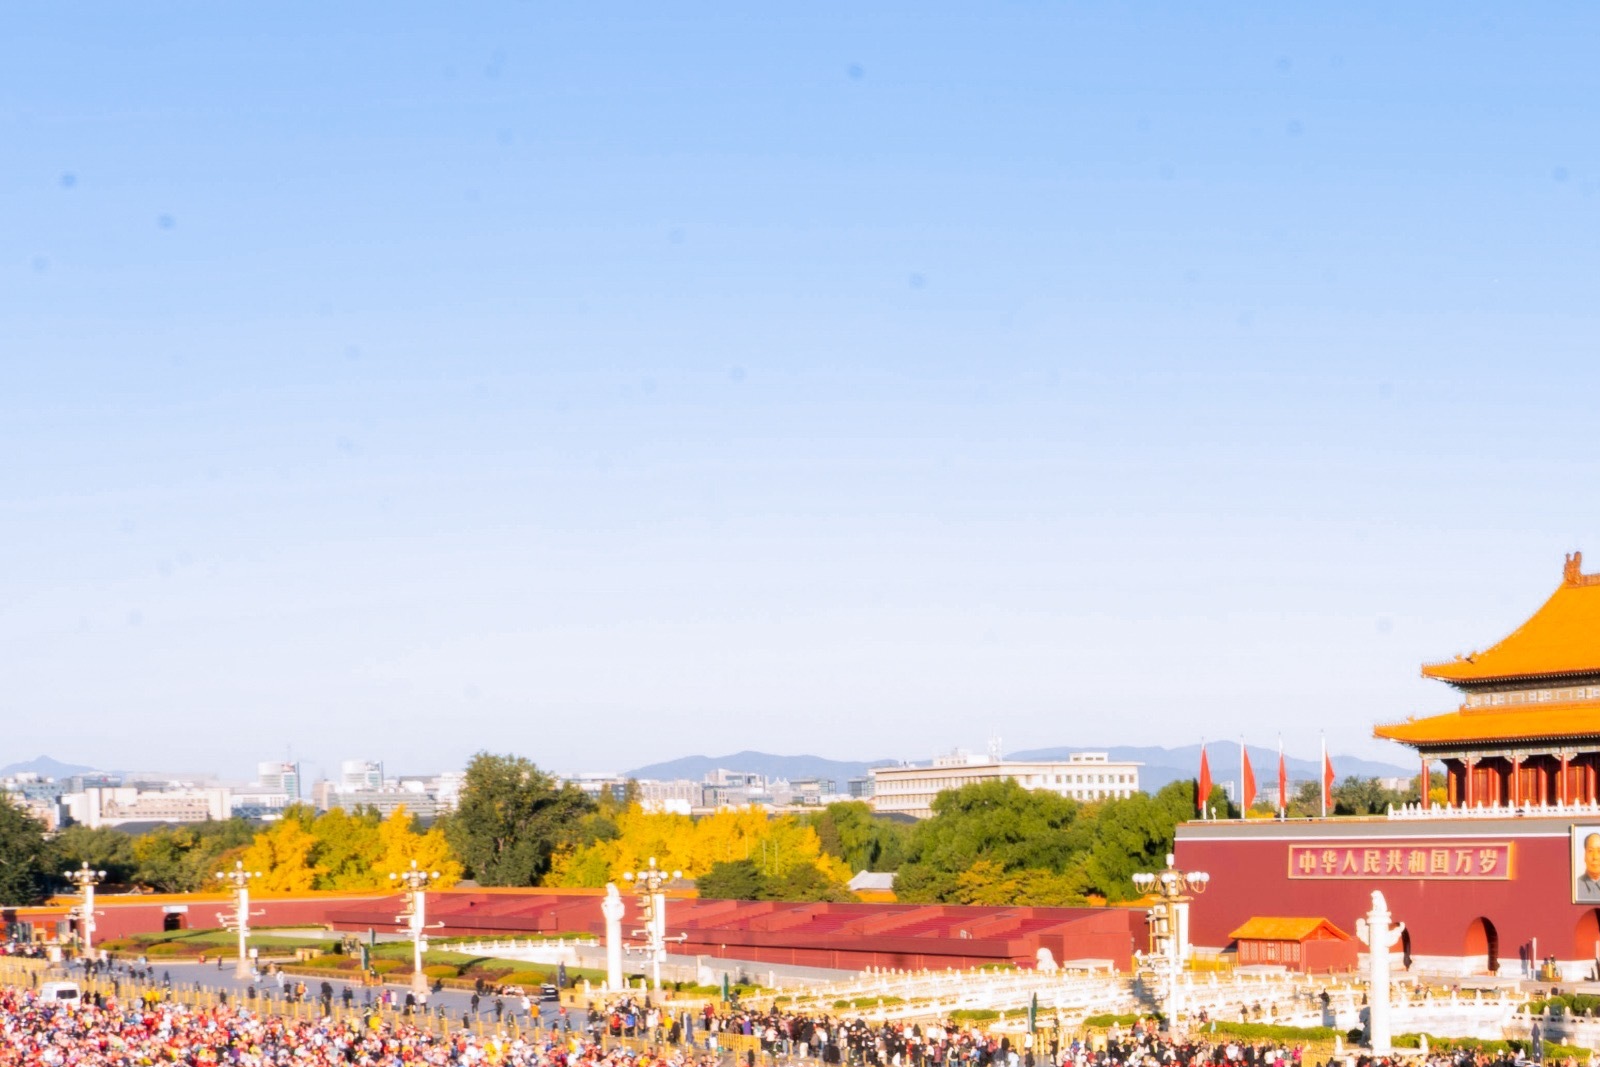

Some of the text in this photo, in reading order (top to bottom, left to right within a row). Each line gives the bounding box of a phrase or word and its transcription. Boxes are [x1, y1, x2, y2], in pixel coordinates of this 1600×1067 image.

[1299, 849, 1499, 875] 中华人民共和国万岁
